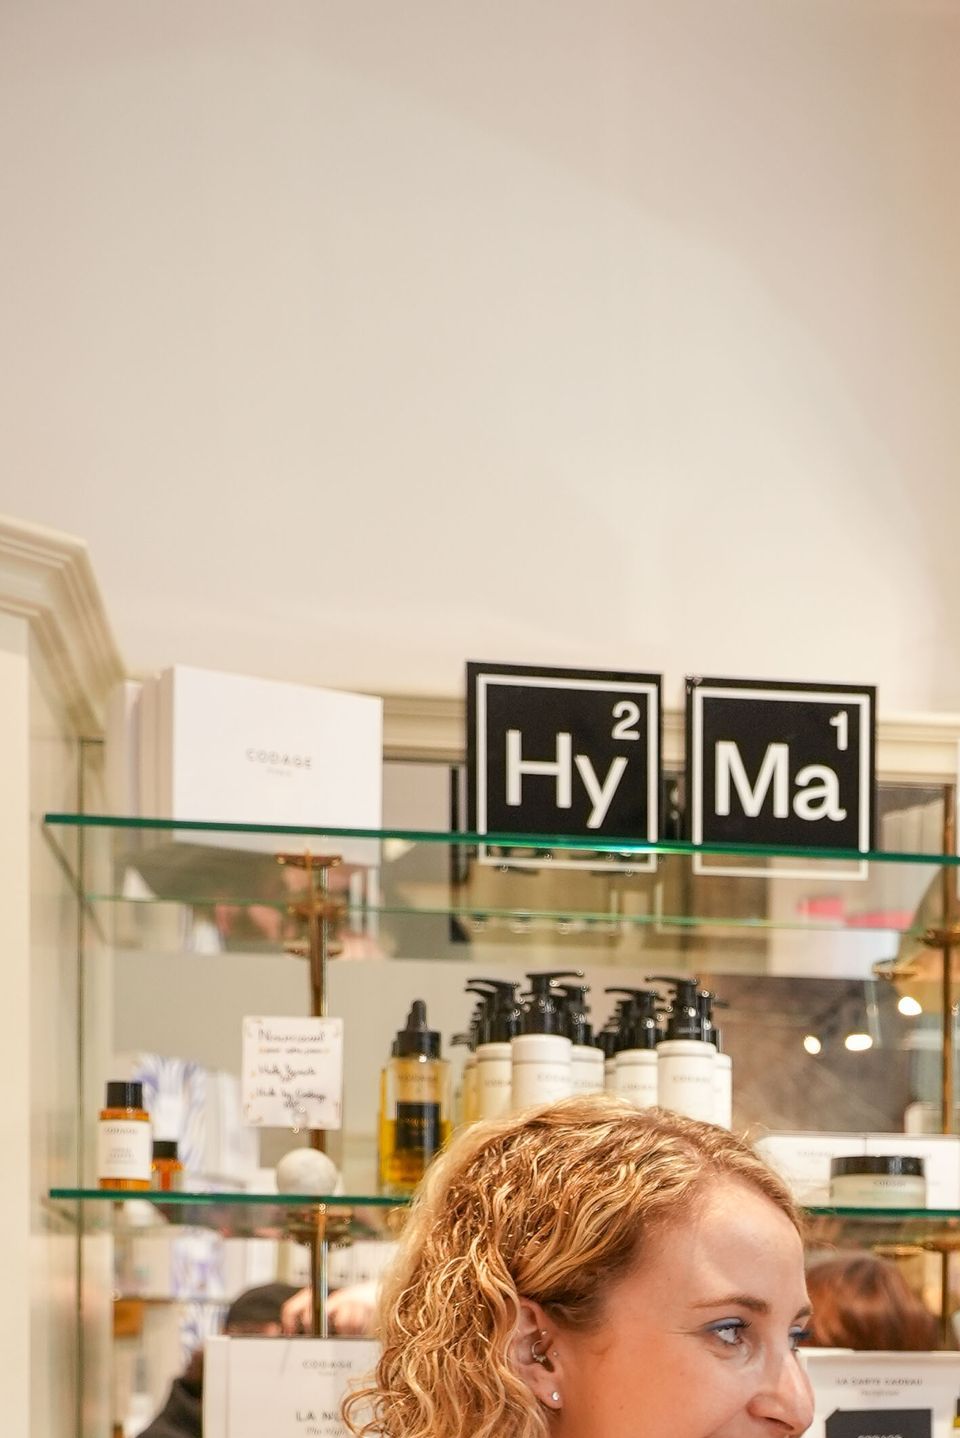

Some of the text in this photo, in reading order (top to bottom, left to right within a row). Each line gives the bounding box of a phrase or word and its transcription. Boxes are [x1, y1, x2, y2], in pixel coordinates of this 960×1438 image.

[612, 701, 640, 740] 2
[829, 711, 848, 750] 1
[245, 748, 312, 770] CODAGE
[505, 729, 629, 829] Hy
[714, 740, 847, 822] Ma
